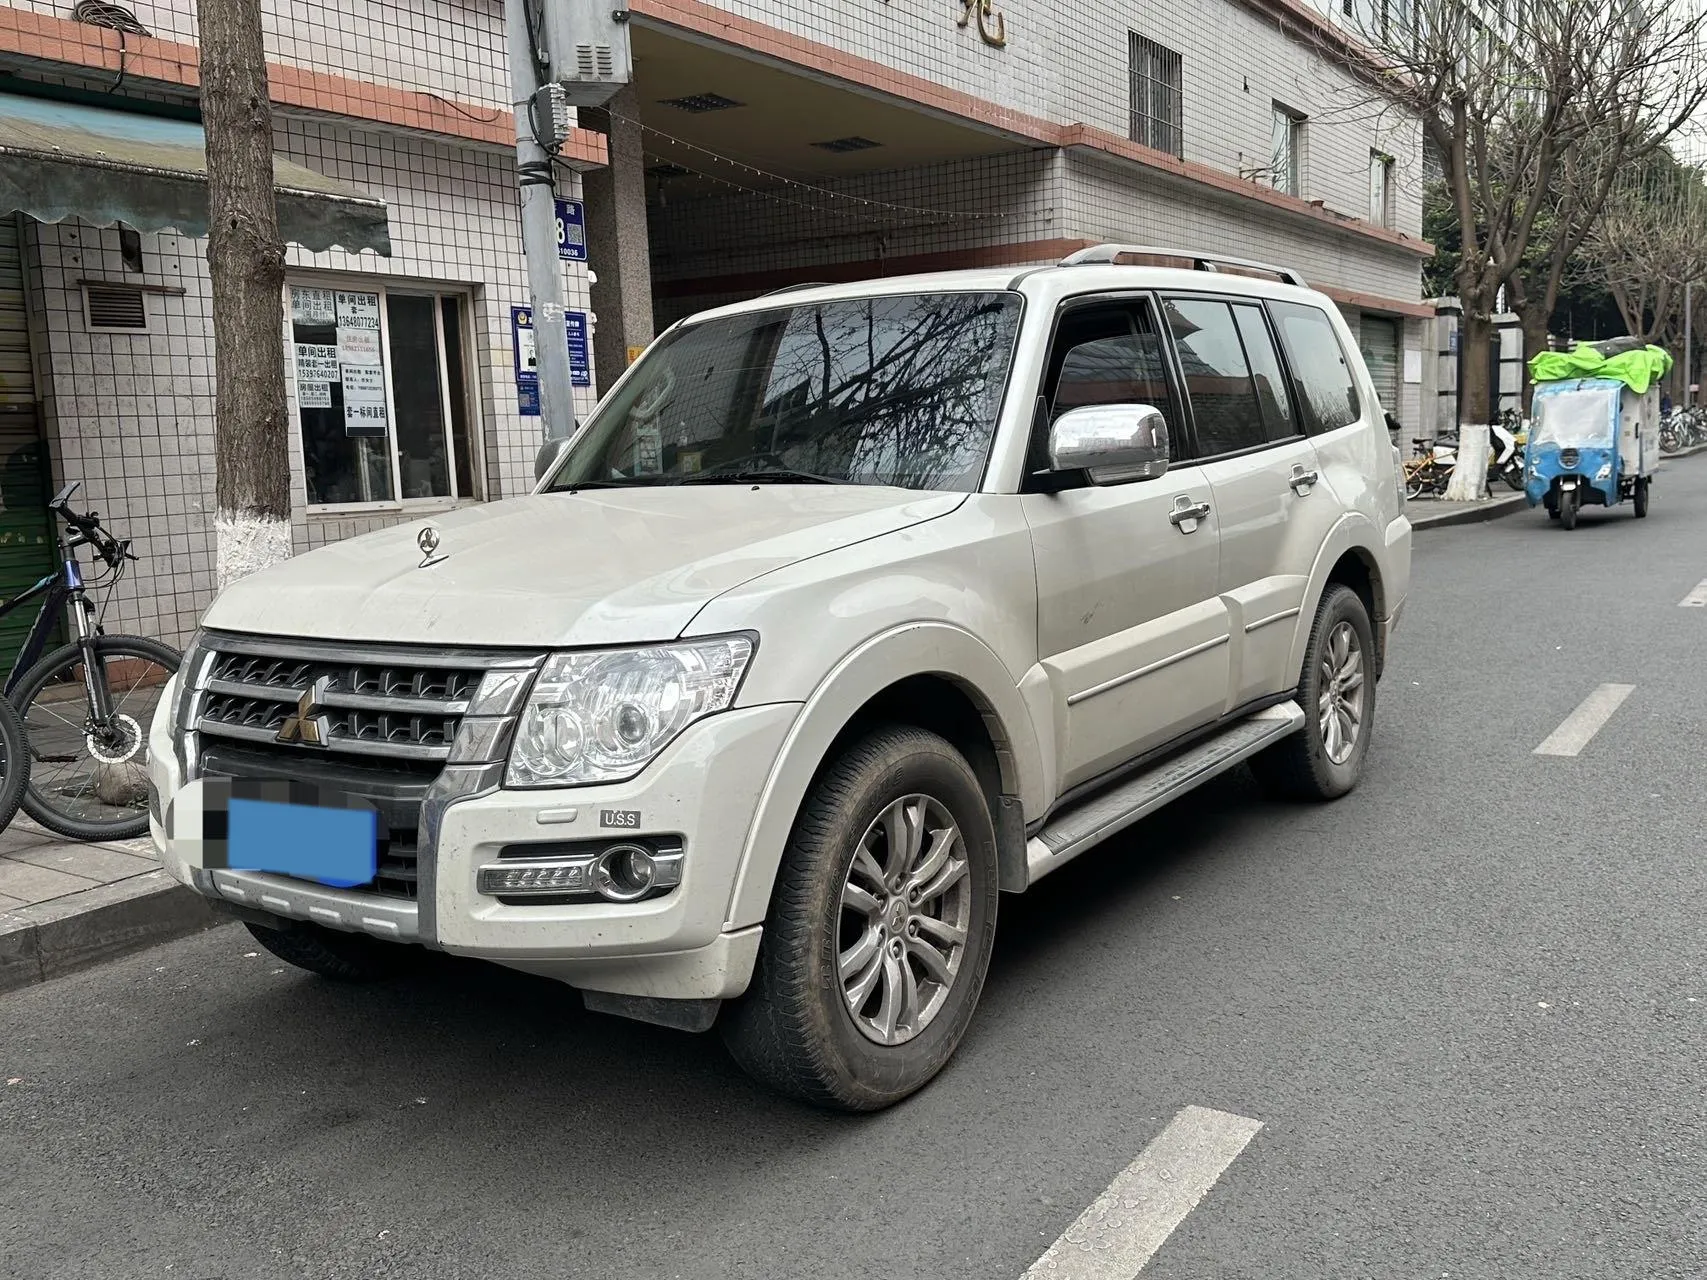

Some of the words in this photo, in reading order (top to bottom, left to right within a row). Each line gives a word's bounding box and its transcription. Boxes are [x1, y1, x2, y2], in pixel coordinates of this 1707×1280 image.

[559, 248, 578, 257] 10036
[292, 300, 333, 311] 单间出租
[338, 294, 376, 307] 单间出租
[350, 306, 365, 314] 套一
[339, 315, 379, 328] 13648077234
[299, 346, 337, 358] 单间出租
